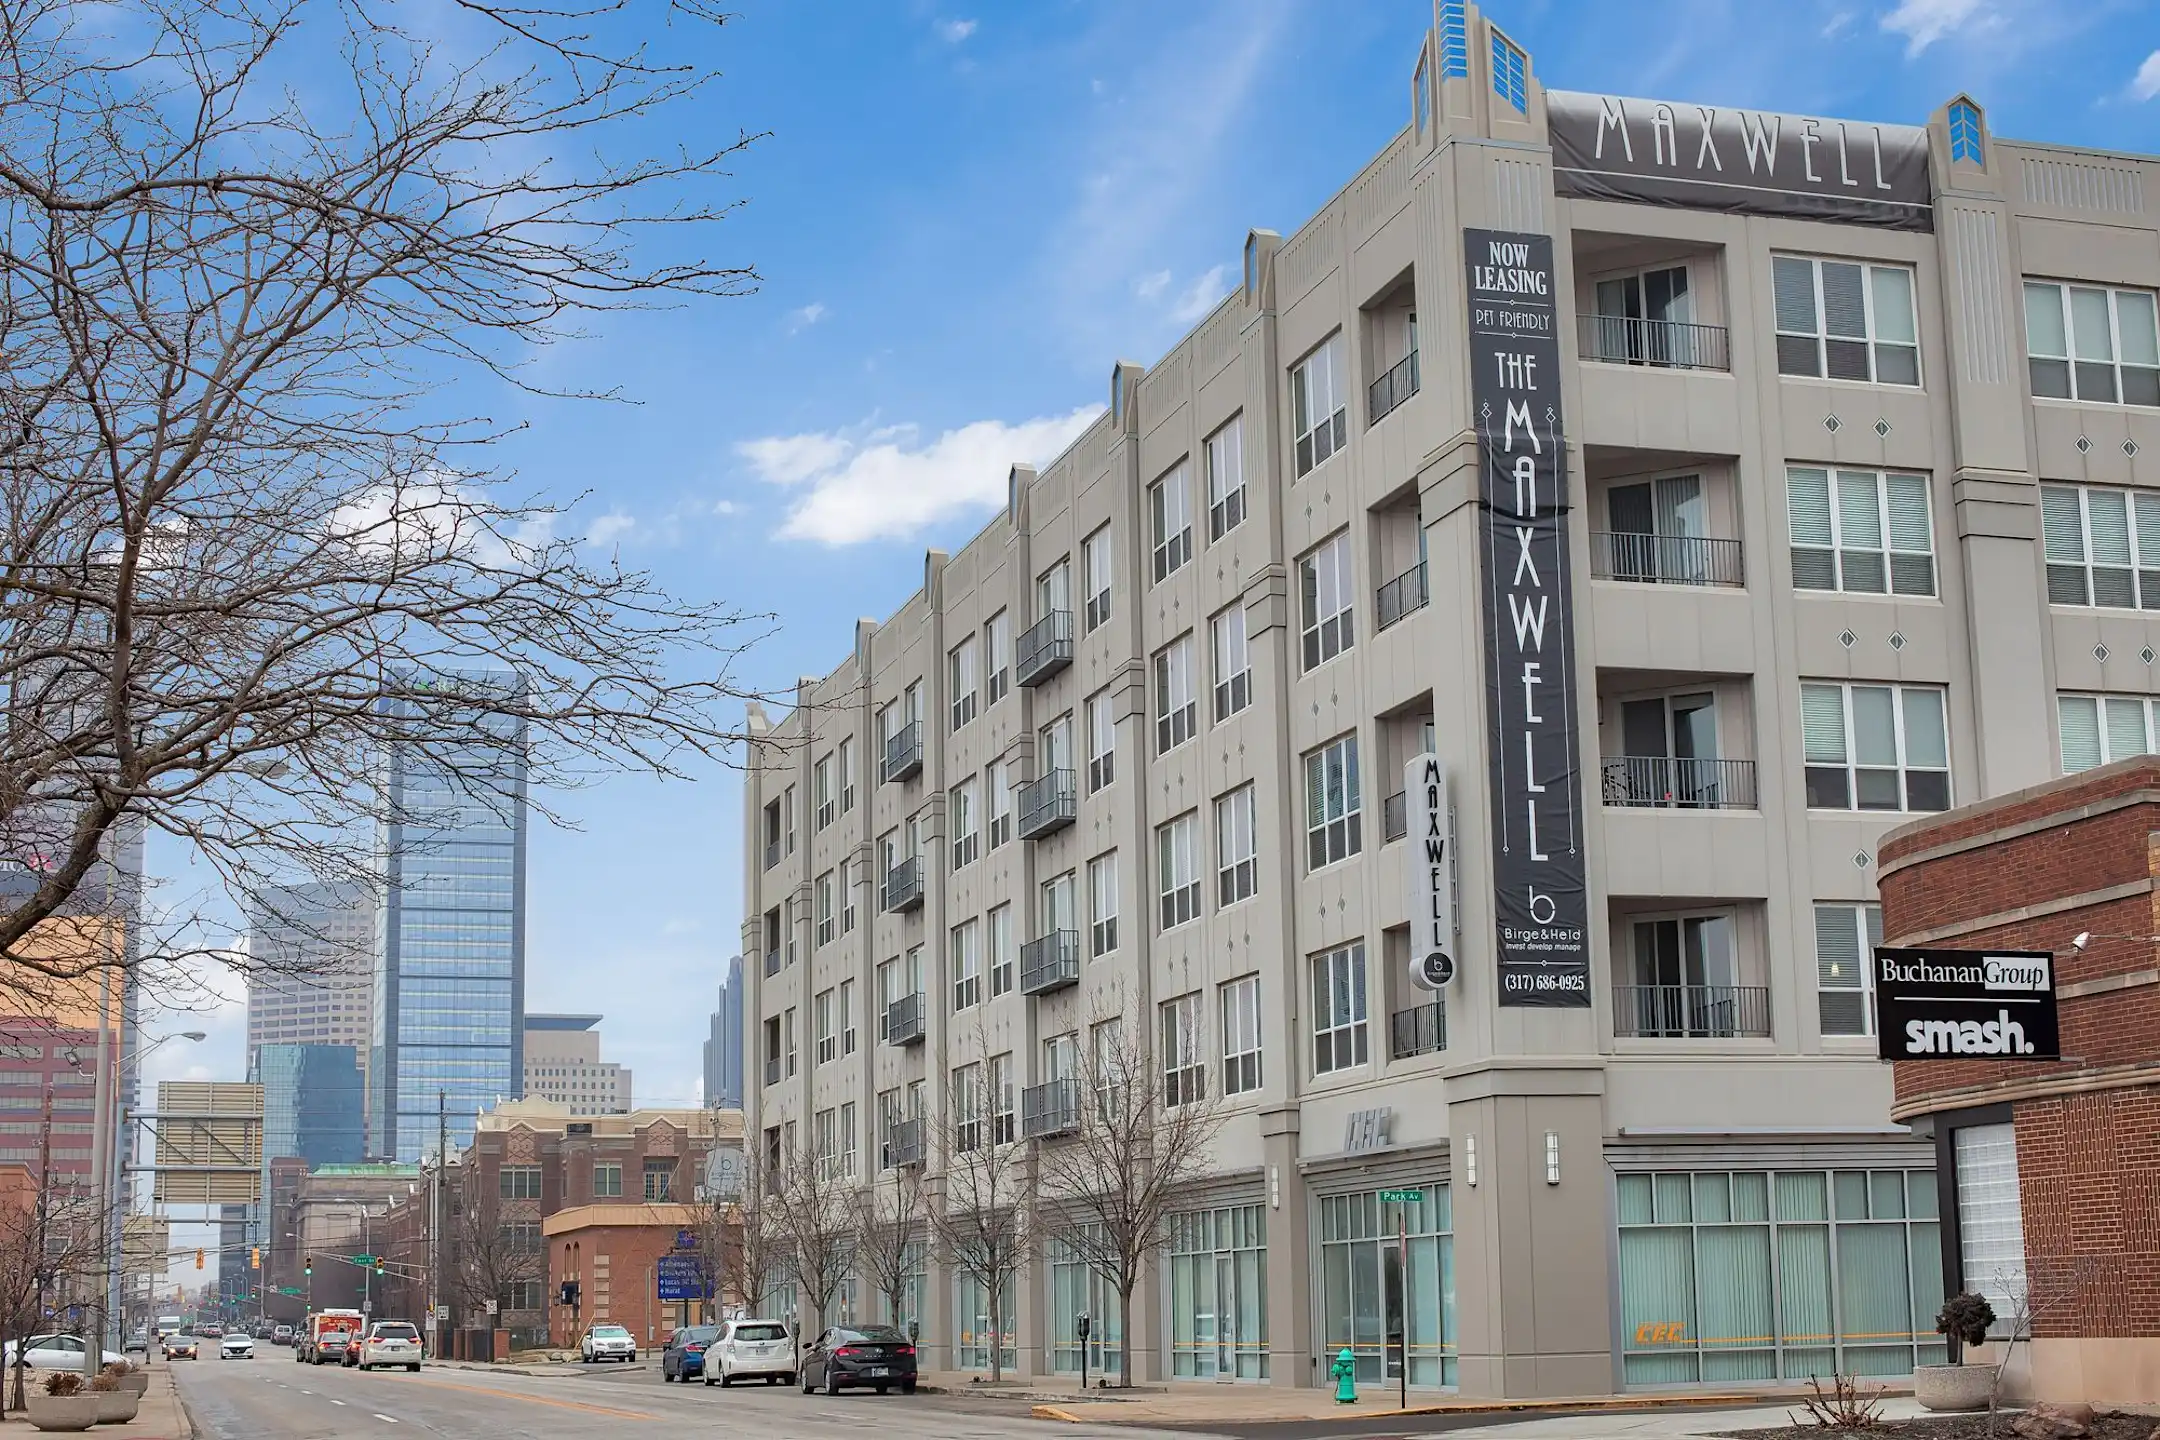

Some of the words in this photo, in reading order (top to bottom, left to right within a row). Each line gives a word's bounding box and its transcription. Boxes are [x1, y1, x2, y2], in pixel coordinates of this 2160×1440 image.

[1595, 96, 1892, 190] MAXWELL
[1488, 241, 1529, 268] NOW
[1474, 265, 1548, 295] LEASING
[1475, 309, 1494, 327] PET
[1500, 309, 1550, 330] FRIENDLY
[1494, 351, 1537, 391] THE
[1503, 398, 1548, 862] MAXWELL
[1424, 759, 1444, 947] MAXWELL
[1504, 927, 1581, 942] Birge&Held
[1527, 943, 1553, 952] develop
[1554, 944, 1581, 952] manage
[1504, 973, 1534, 993] (317)
[1536, 974, 1585, 991] 686-0925
[1906, 1009, 2034, 1055] smash.
[1383, 1192, 1407, 1201] Park
